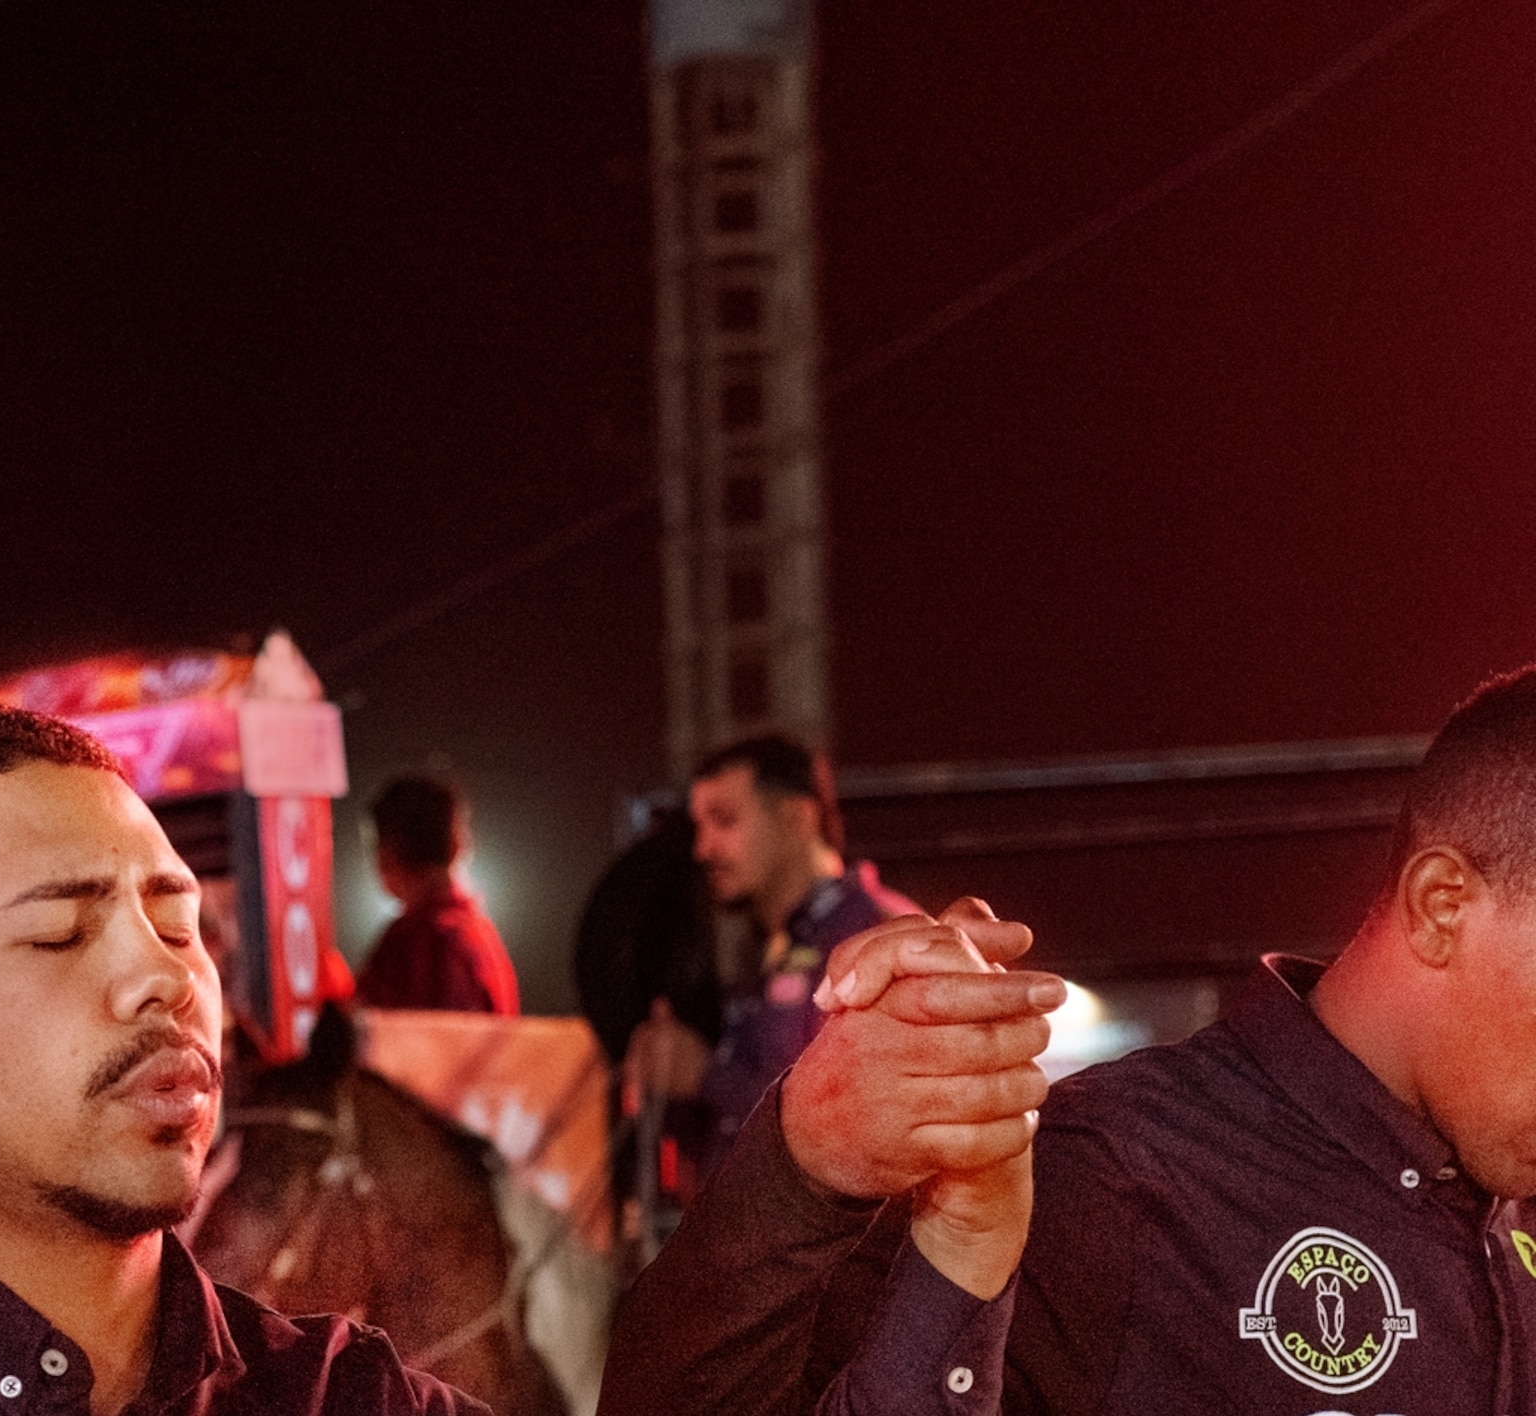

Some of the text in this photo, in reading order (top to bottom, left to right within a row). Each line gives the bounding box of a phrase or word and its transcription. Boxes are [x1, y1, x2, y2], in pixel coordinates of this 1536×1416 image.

[1287, 1246, 1370, 1284] ESPAÇO
[1382, 1318, 1409, 1331] 2012
[1283, 1332, 1381, 1376] COUNTRY
